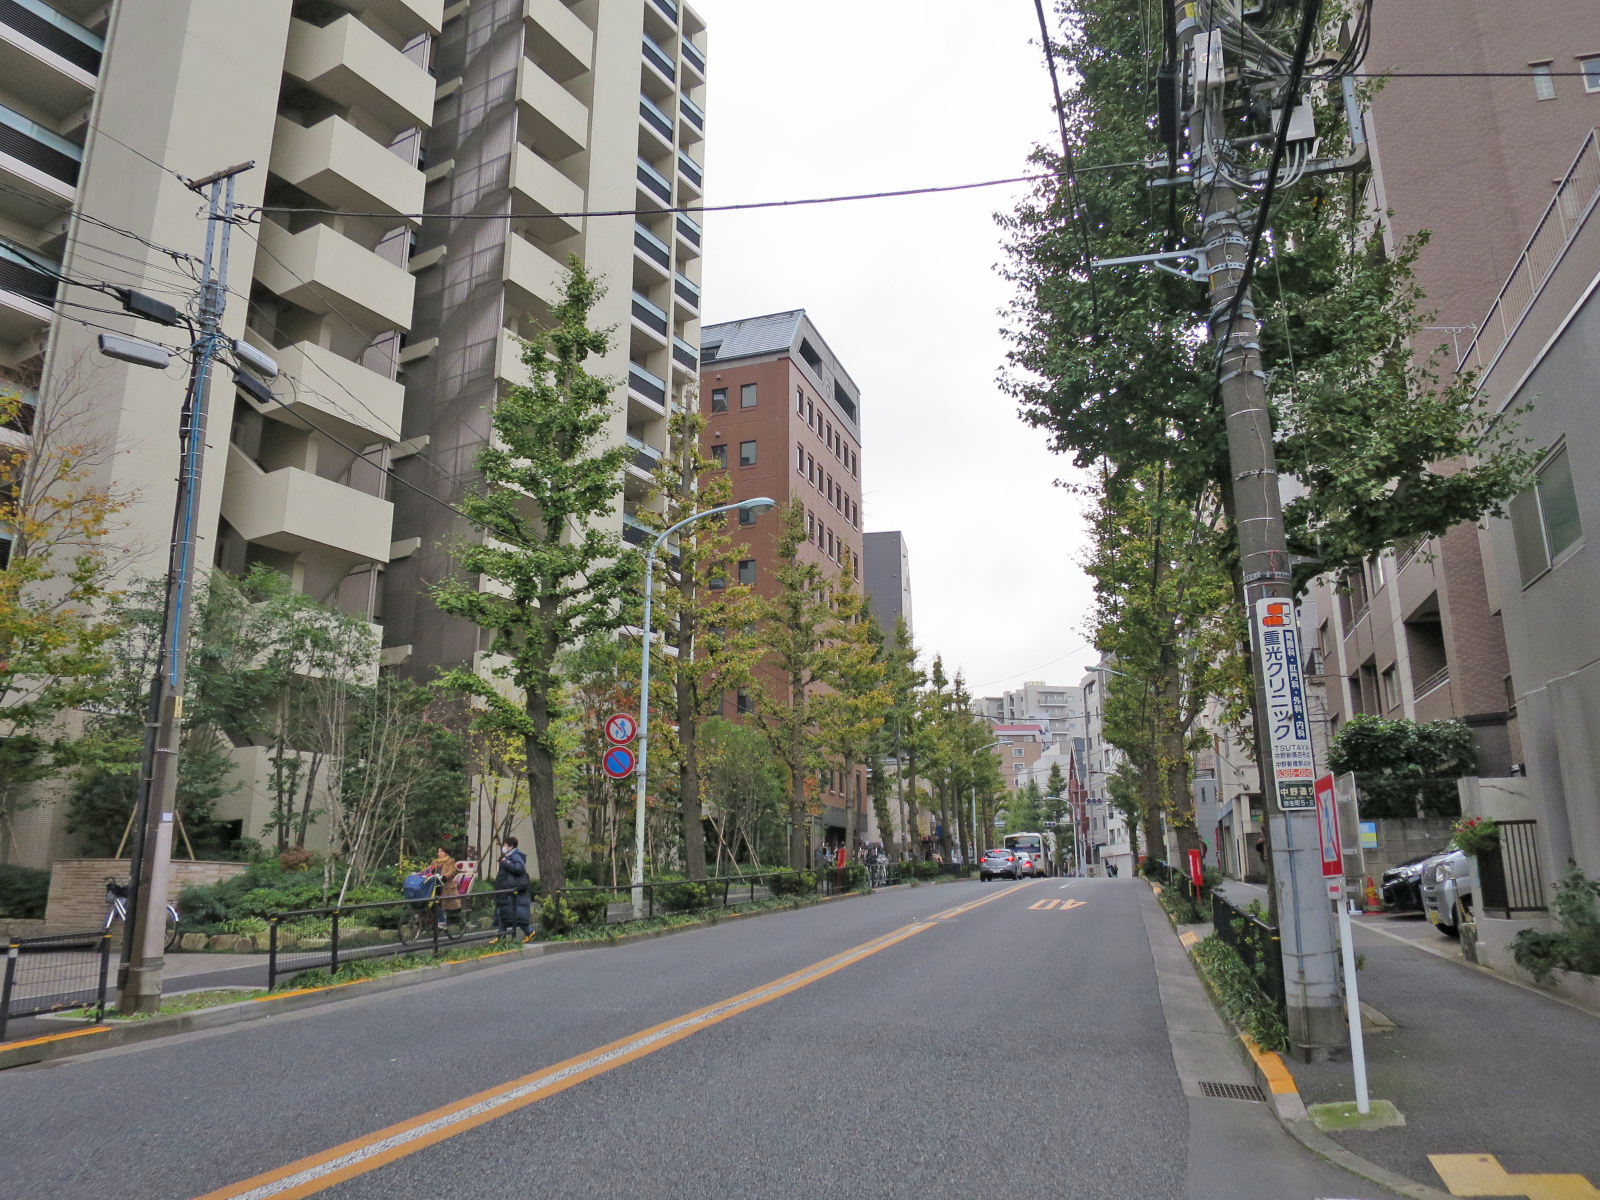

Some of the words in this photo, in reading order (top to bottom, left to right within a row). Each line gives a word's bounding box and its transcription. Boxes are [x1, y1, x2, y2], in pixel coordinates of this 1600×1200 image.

[1263, 631, 1290, 741] 重光クリニック
[1274, 744, 1310, 752] TSUTAYA
[1281, 787, 1313, 797] 中野通り
[1028, 899, 1088, 910] 40
